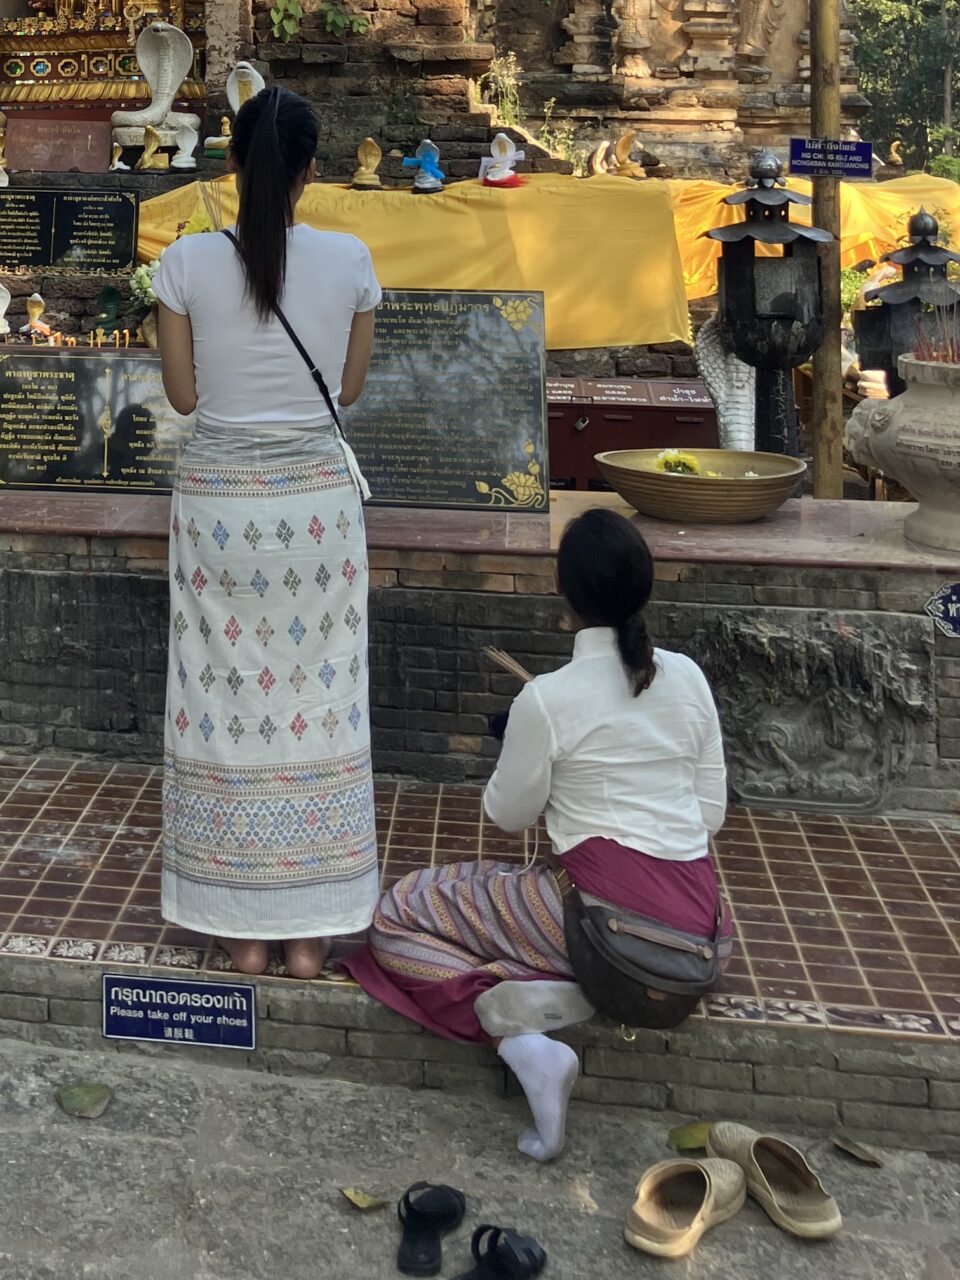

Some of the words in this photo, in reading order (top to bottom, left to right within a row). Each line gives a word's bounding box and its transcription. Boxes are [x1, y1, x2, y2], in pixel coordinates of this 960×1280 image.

[111, 987, 247, 1011] กรุณาถอดรองเท้า
[110, 1005, 144, 1018] Please
[147, 1009, 170, 1020] take
[172, 1012, 188, 1022] off
[190, 1014, 214, 1025] your
[216, 1015, 248, 1027] shoes
